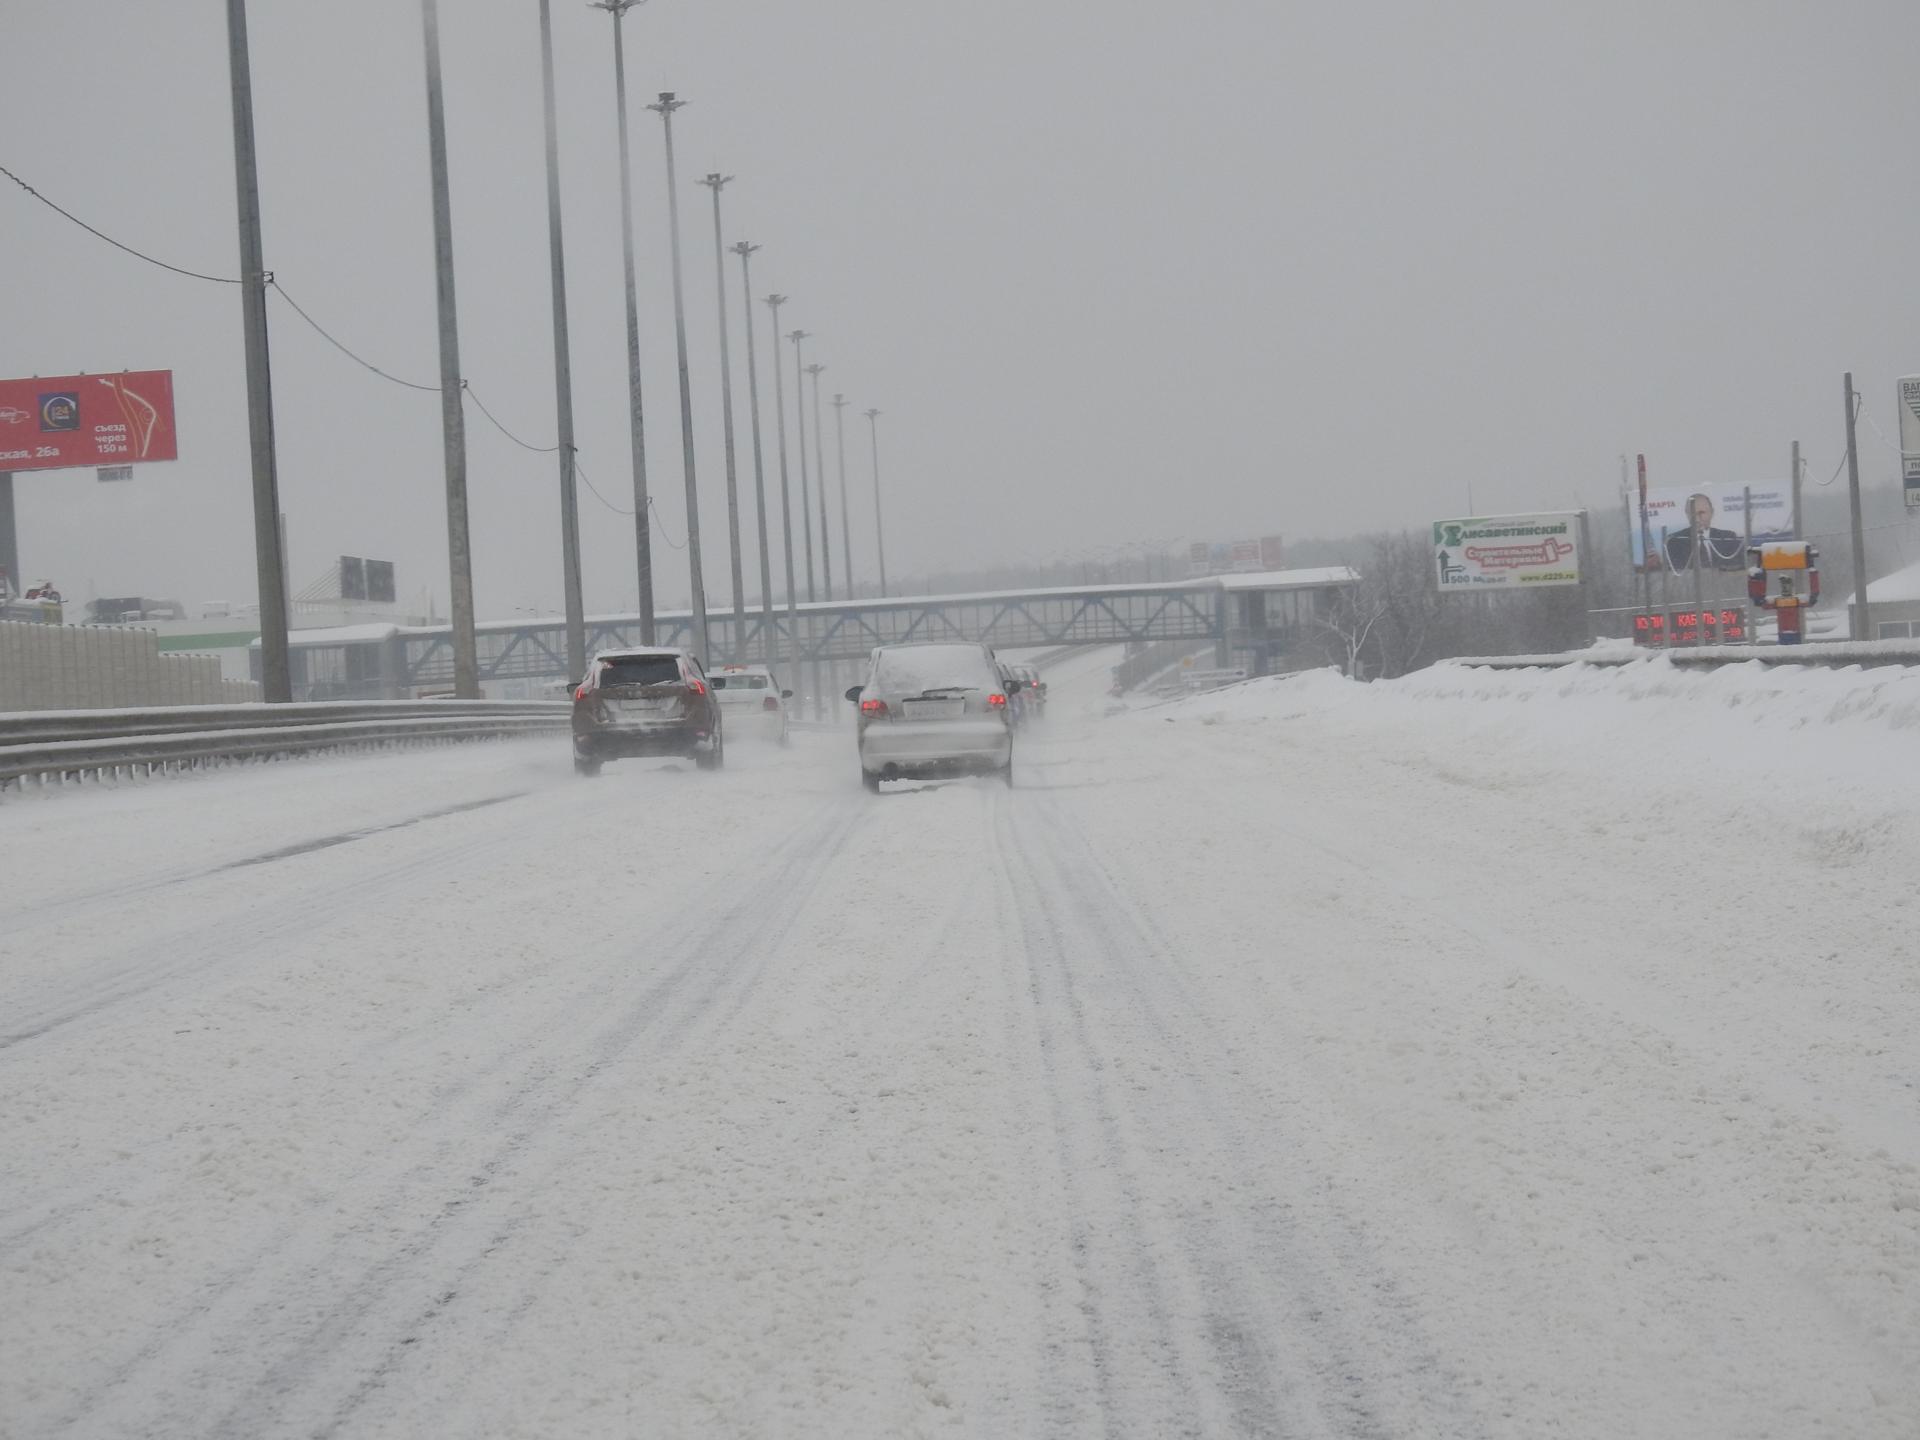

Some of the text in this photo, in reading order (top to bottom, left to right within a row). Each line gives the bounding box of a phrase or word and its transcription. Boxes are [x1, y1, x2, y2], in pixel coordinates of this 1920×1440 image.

[95, 424, 127, 432] съезд
[95, 434, 127, 444] через
[36, 446, 60, 457] 26а
[97, 444, 116, 453] 150
[1648, 501, 1676, 509] МАРТА
[1450, 575, 1470, 584] 500
[1678, 612, 1717, 627] КАБЛЬ
